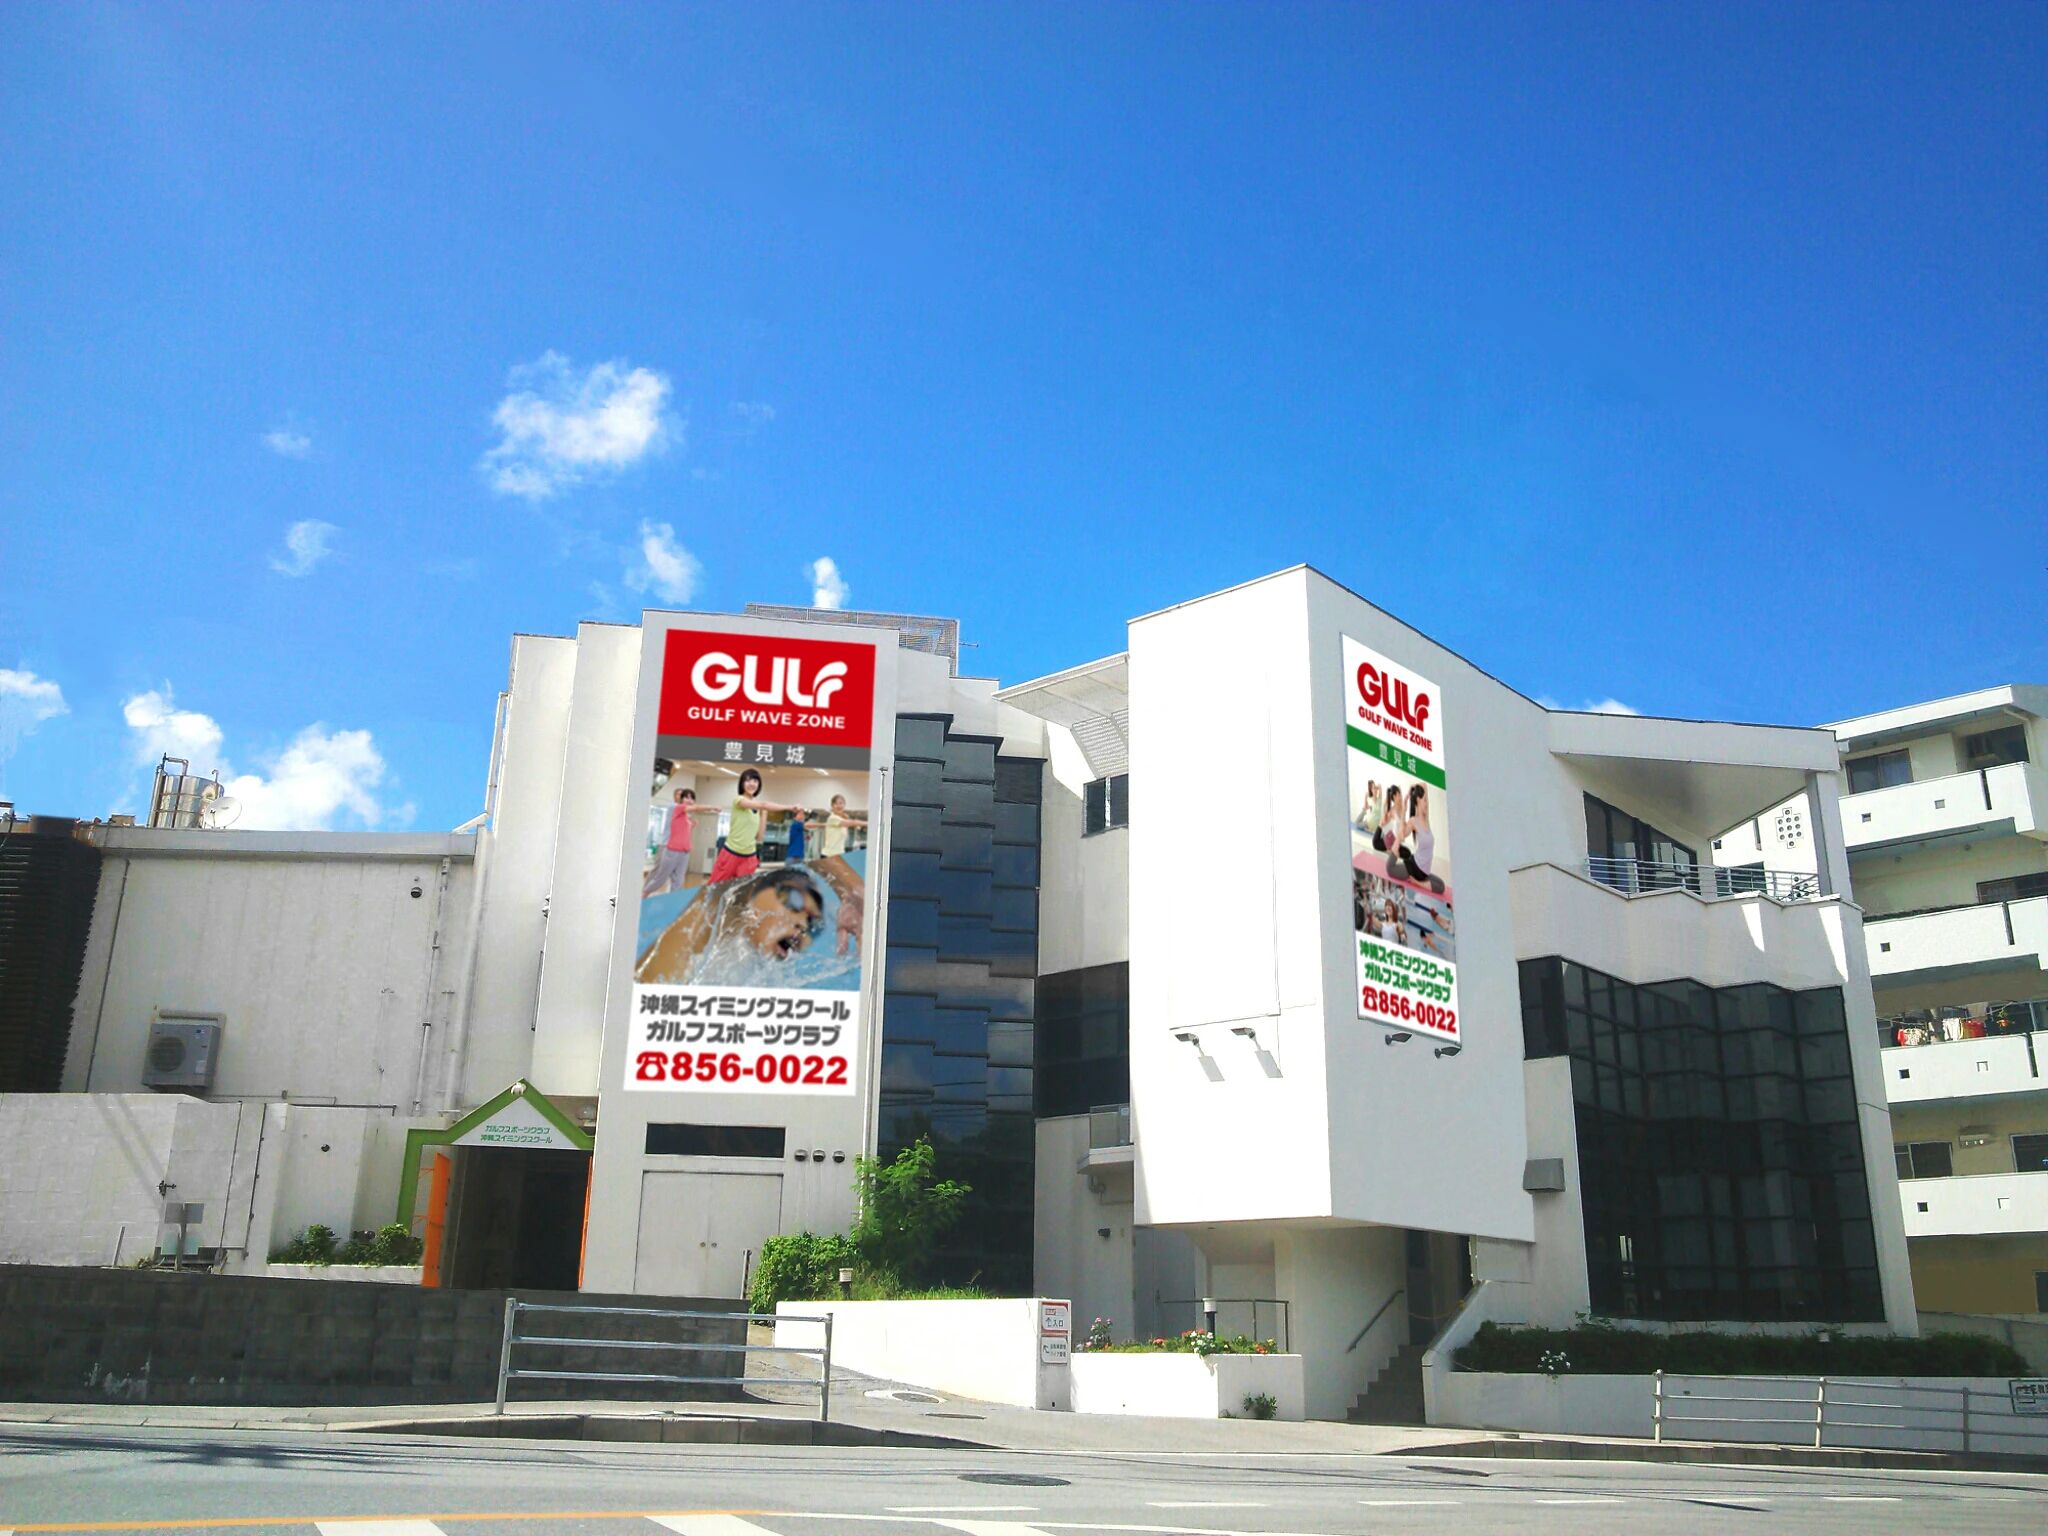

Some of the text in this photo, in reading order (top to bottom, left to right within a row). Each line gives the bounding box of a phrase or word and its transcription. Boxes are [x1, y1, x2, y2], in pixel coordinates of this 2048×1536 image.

[691, 651, 848, 709] GULF
[1357, 661, 1430, 732] GULF
[687, 707, 846, 729] GULF WAVE ZONE
[1358, 706, 1433, 752] GULF WAVE ZONE
[723, 741, 805, 765] 豊見城
[640, 993, 851, 1021] 沖縄スイミングスクール
[1378, 989, 1457, 1034] 856-0022
[646, 1020, 842, 1047] ガルフスポーツクラブ
[670, 1051, 848, 1085] 856-0022
